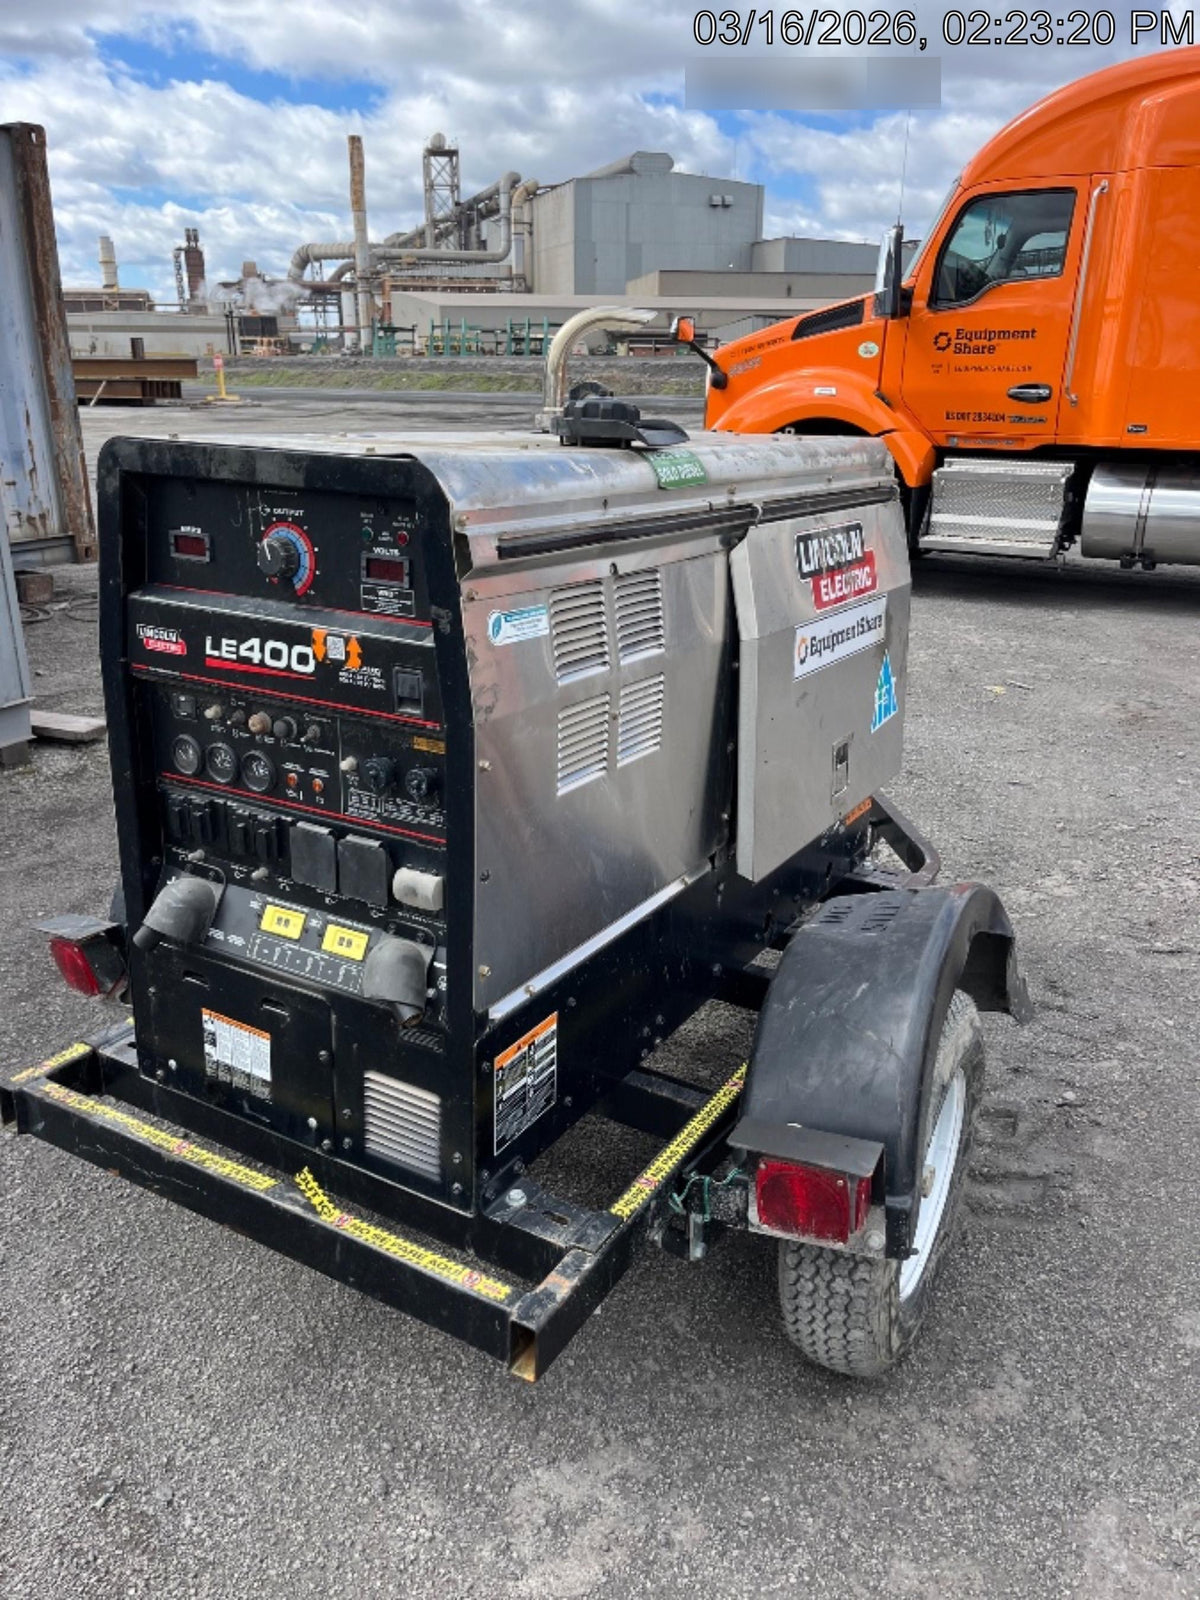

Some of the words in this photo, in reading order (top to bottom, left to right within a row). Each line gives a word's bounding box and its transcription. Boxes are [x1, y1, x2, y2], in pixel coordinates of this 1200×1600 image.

[956, 328, 1037, 342] Equipment
[954, 343, 996, 354] Share
[273, 508, 305, 517] OUTPUT
[373, 546, 401, 557] VOLTS
[799, 530, 863, 573] LINCOLN
[819, 566, 873, 603] ELECTRIC
[139, 625, 179, 643] LINCOLN
[809, 614, 884, 660] EquipmentShare
[205, 635, 316, 673] LE400
